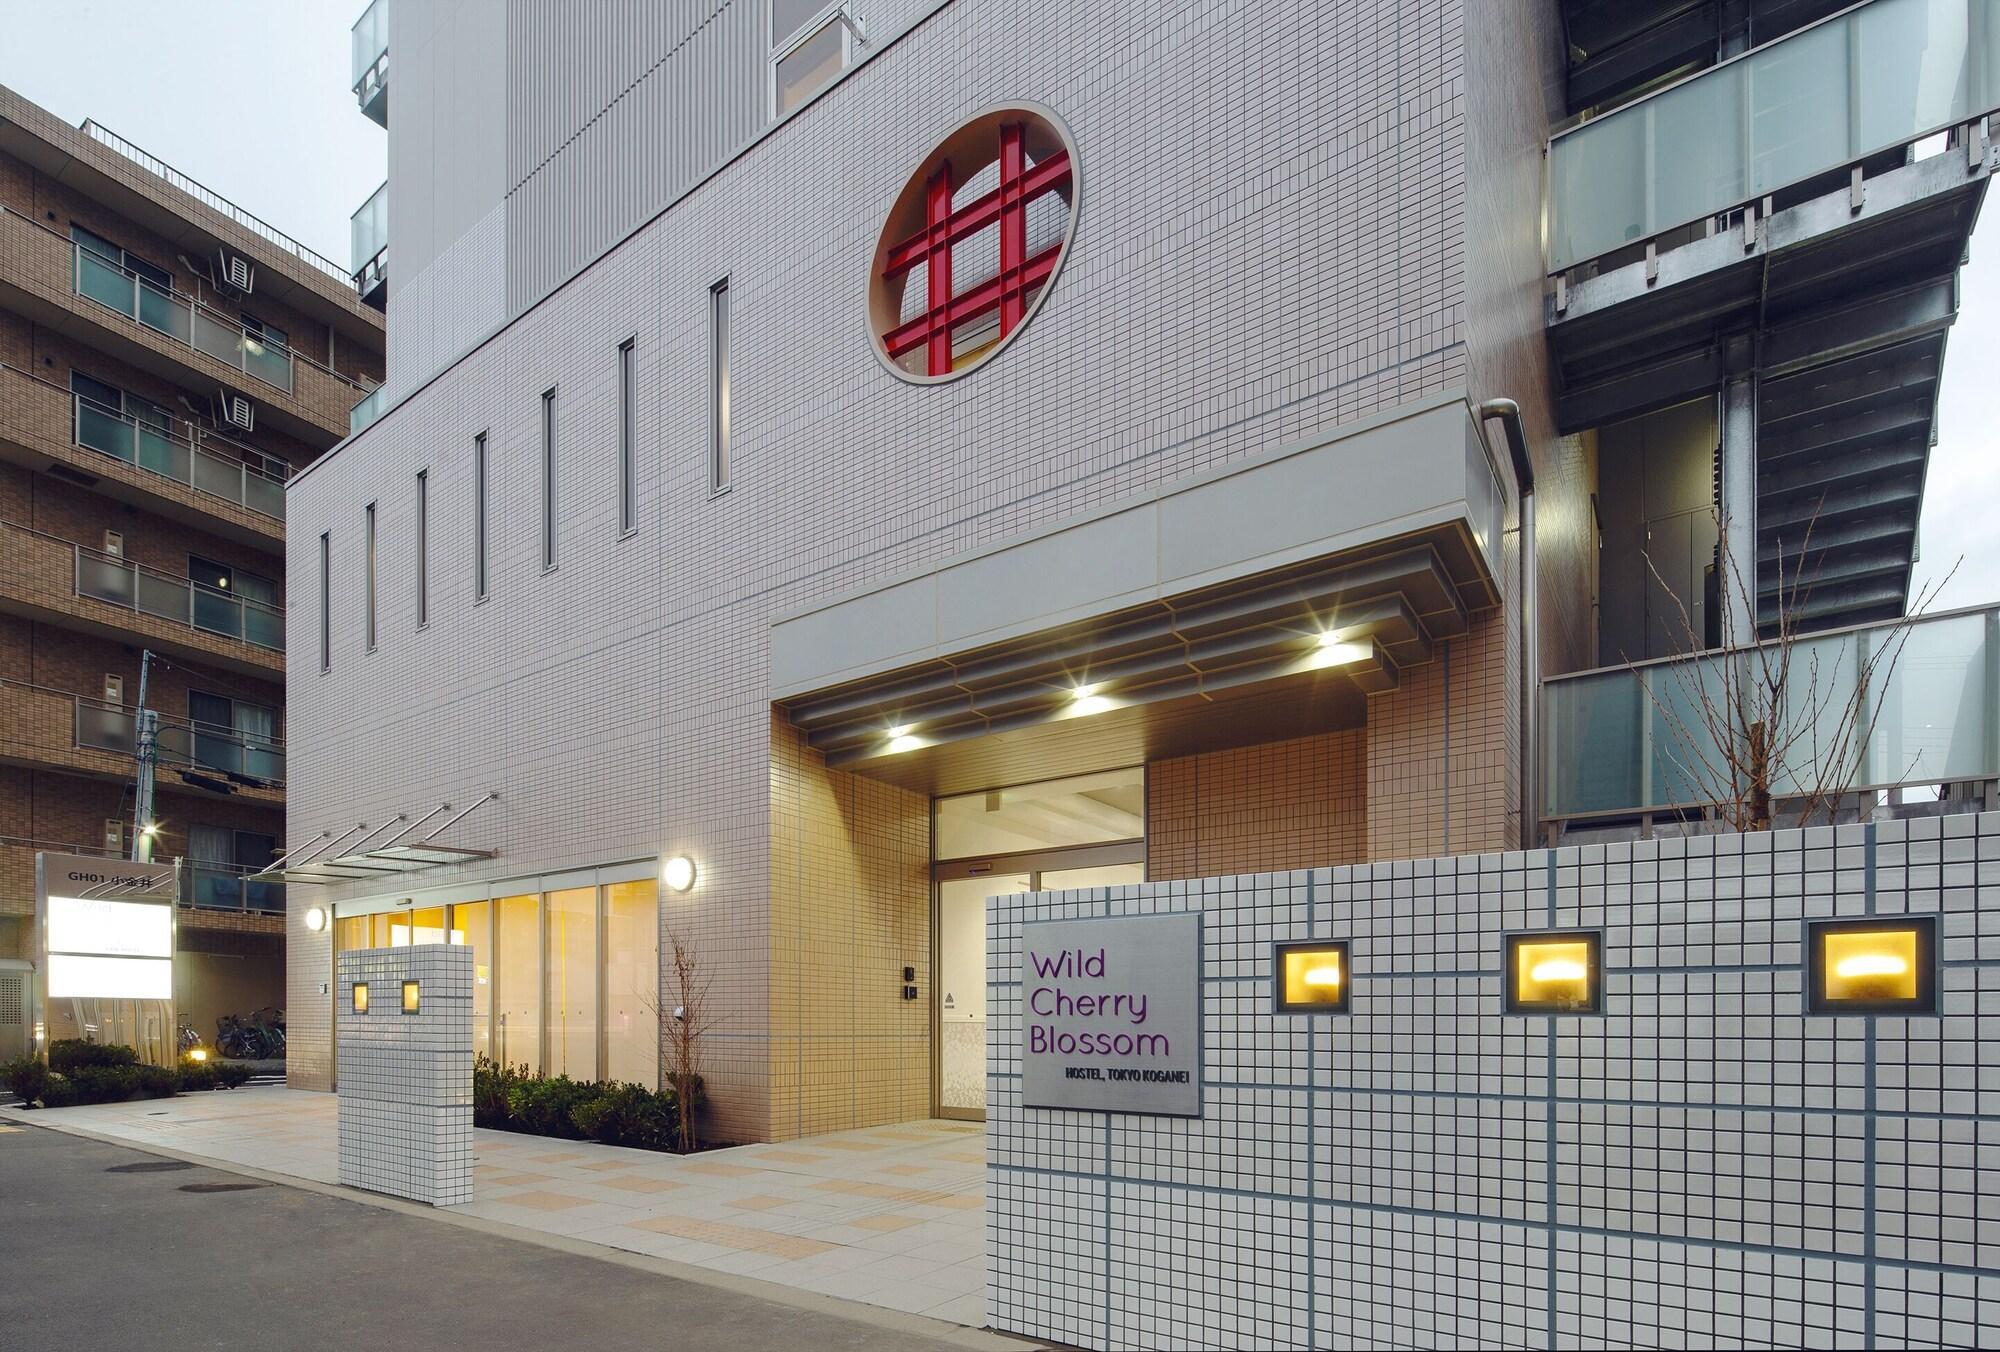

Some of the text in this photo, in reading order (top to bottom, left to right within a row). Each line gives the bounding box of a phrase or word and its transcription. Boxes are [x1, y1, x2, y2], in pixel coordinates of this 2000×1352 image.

[68, 872, 153, 888] GH01 小金井
[1030, 948, 1105, 978] Wild
[1030, 987, 1147, 1024] Cherry
[1030, 1025, 1169, 1056] Blossom
[1065, 1067, 1190, 1084] HOSTEL, TOKYO KOGANEI
